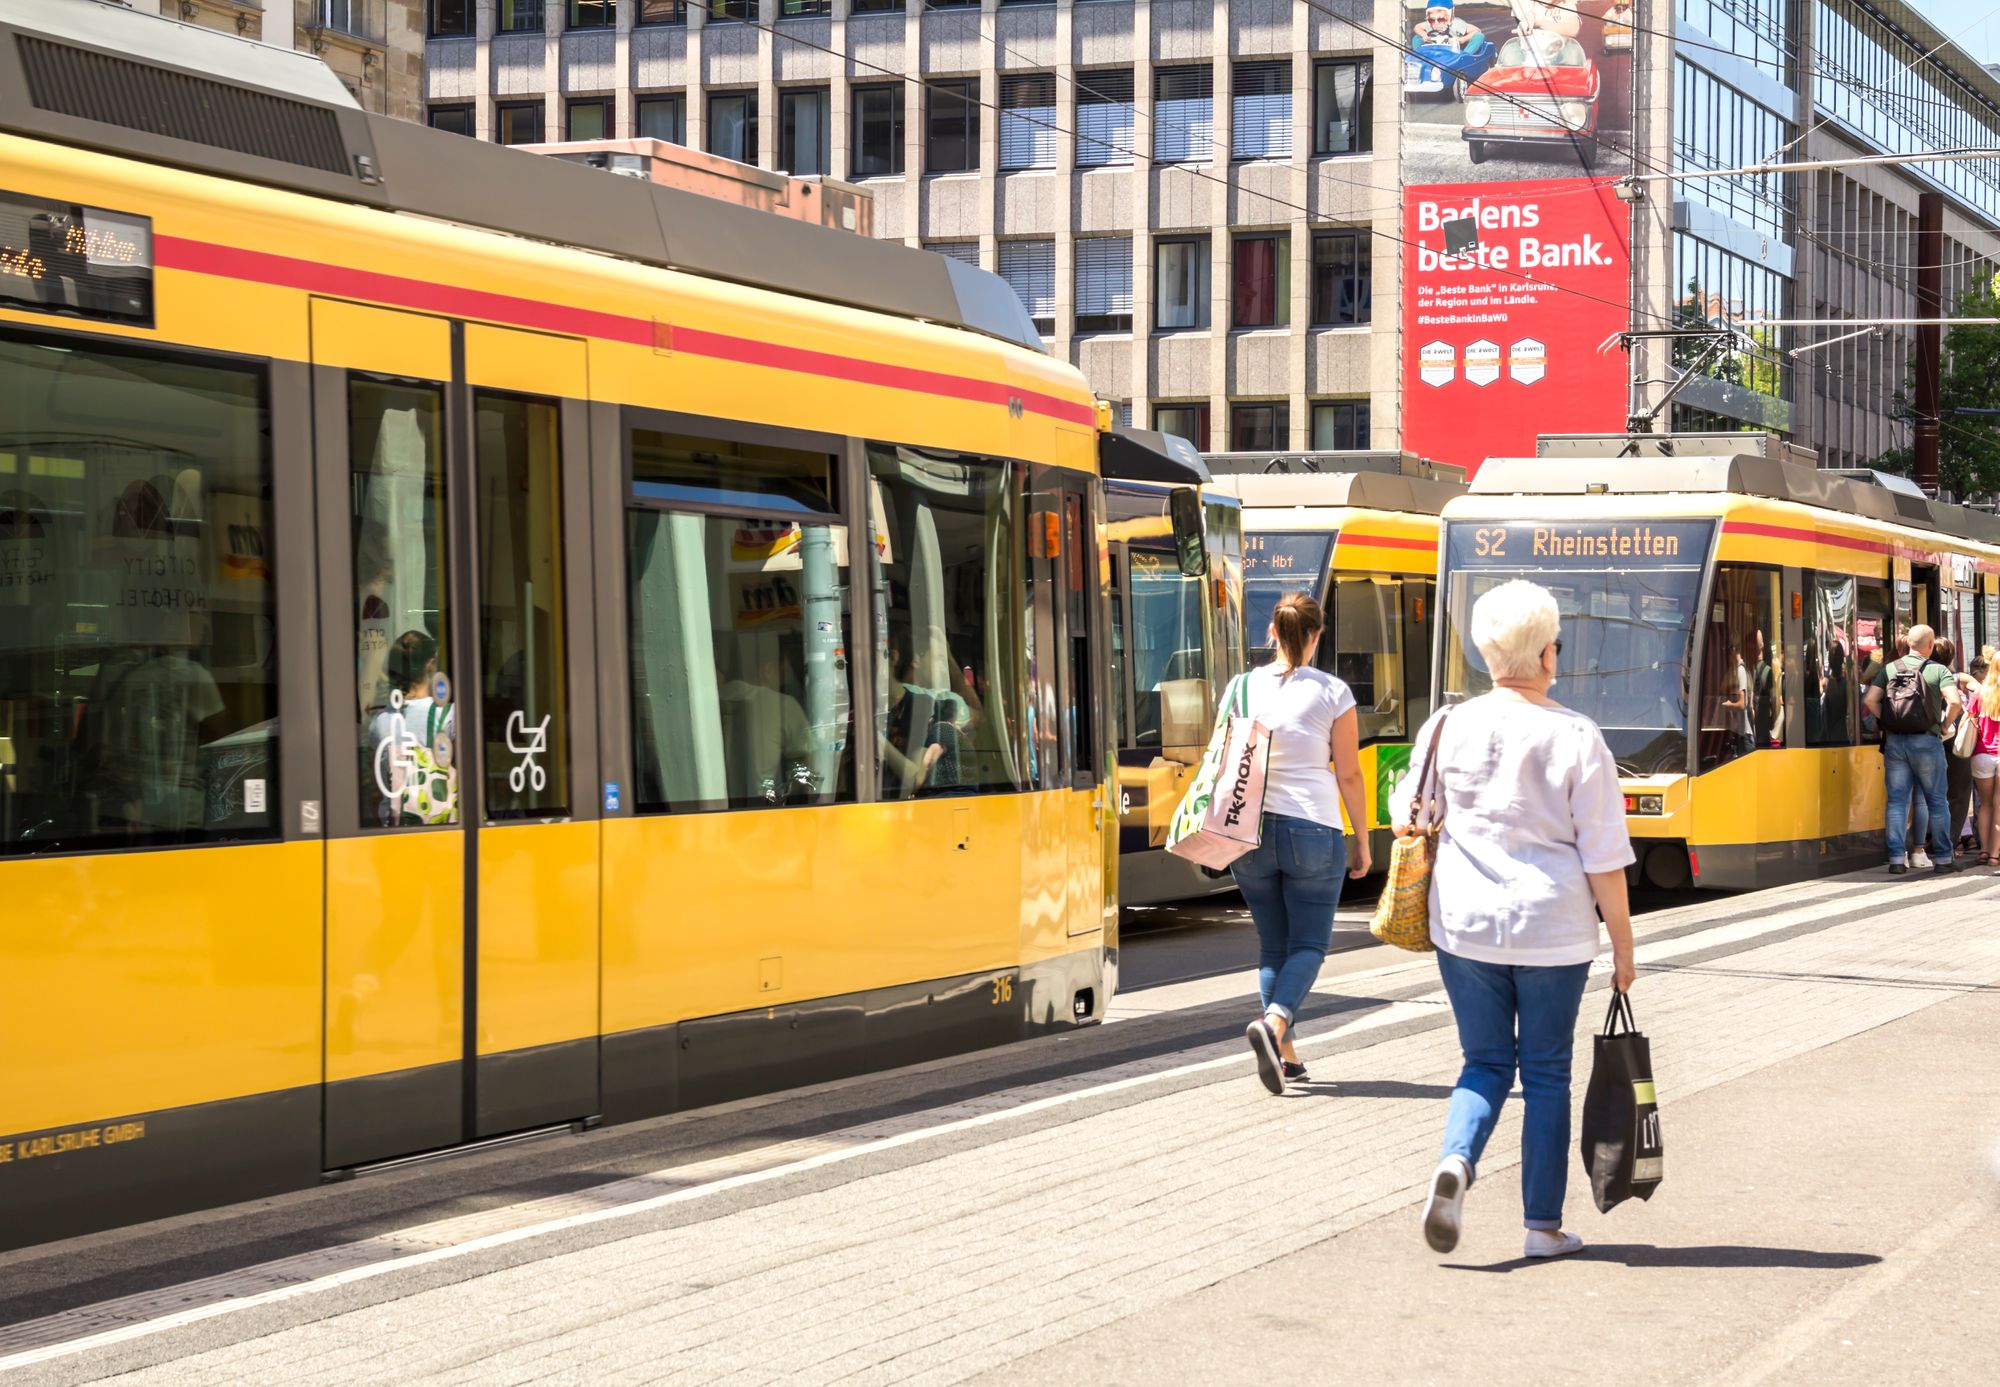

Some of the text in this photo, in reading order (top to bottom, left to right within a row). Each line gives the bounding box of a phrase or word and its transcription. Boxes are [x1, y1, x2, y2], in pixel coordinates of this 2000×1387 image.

[1418, 197, 1539, 232] Badens
[1418, 233, 1613, 272] beste Bank.
[1418, 286, 1433, 295] Die
[1498, 283, 1507, 293] in
[1418, 294, 1538, 309] der Region und im Ländle.
[1475, 527, 1678, 556] S2 Rheinstetten
[1272, 554, 1293, 568] Hbf
[992, 975, 1012, 1005] 316
[18, 1128, 101, 1160] KARLSRUHE
